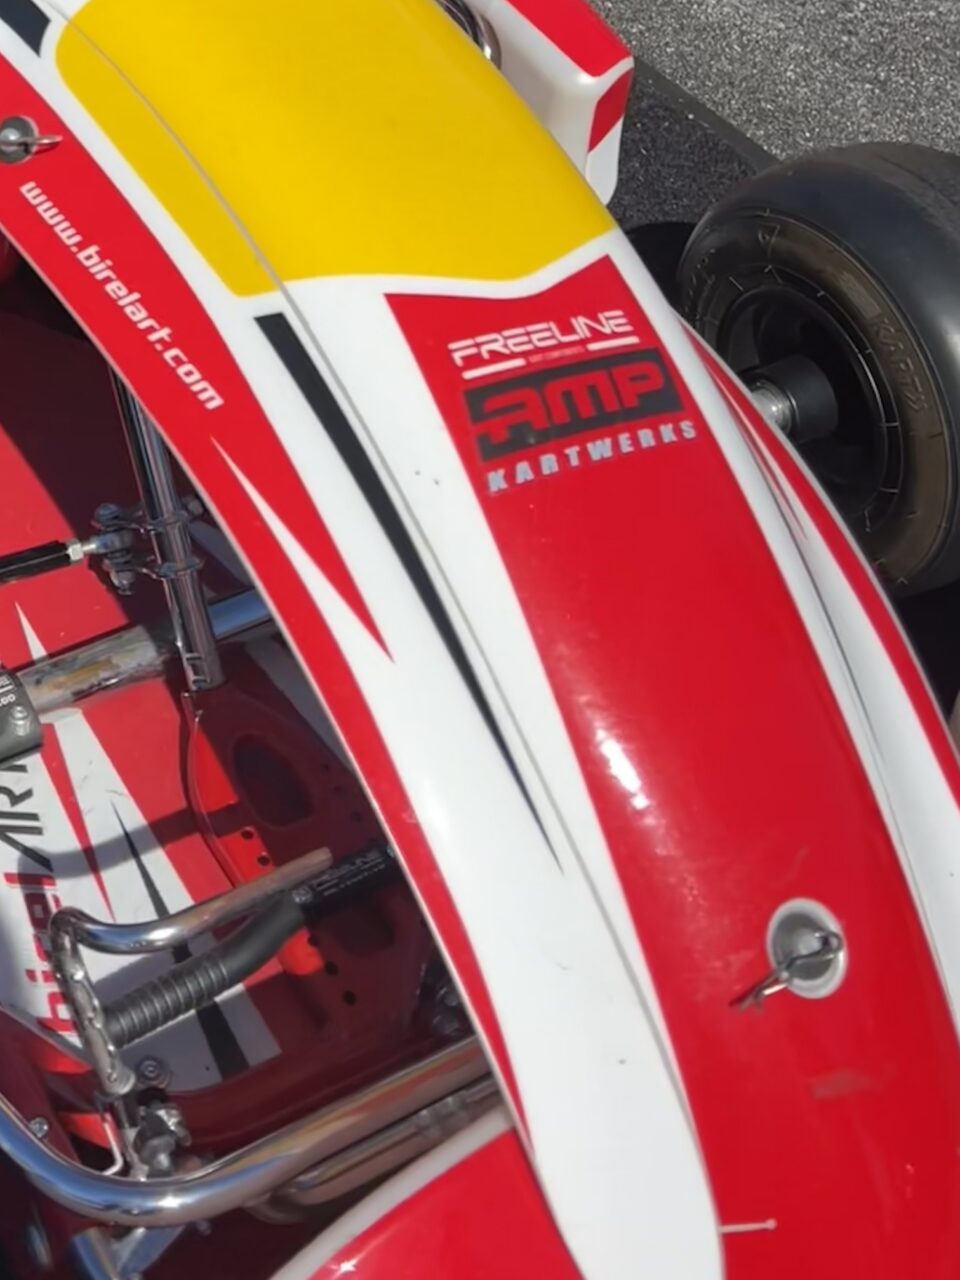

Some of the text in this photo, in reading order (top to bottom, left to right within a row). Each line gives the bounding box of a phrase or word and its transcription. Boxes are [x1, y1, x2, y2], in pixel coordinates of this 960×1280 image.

[19, 180, 225, 411] www.birelart.com
[447, 310, 635, 368] FREELINE
[486, 420, 697, 495] KARTWERKS
